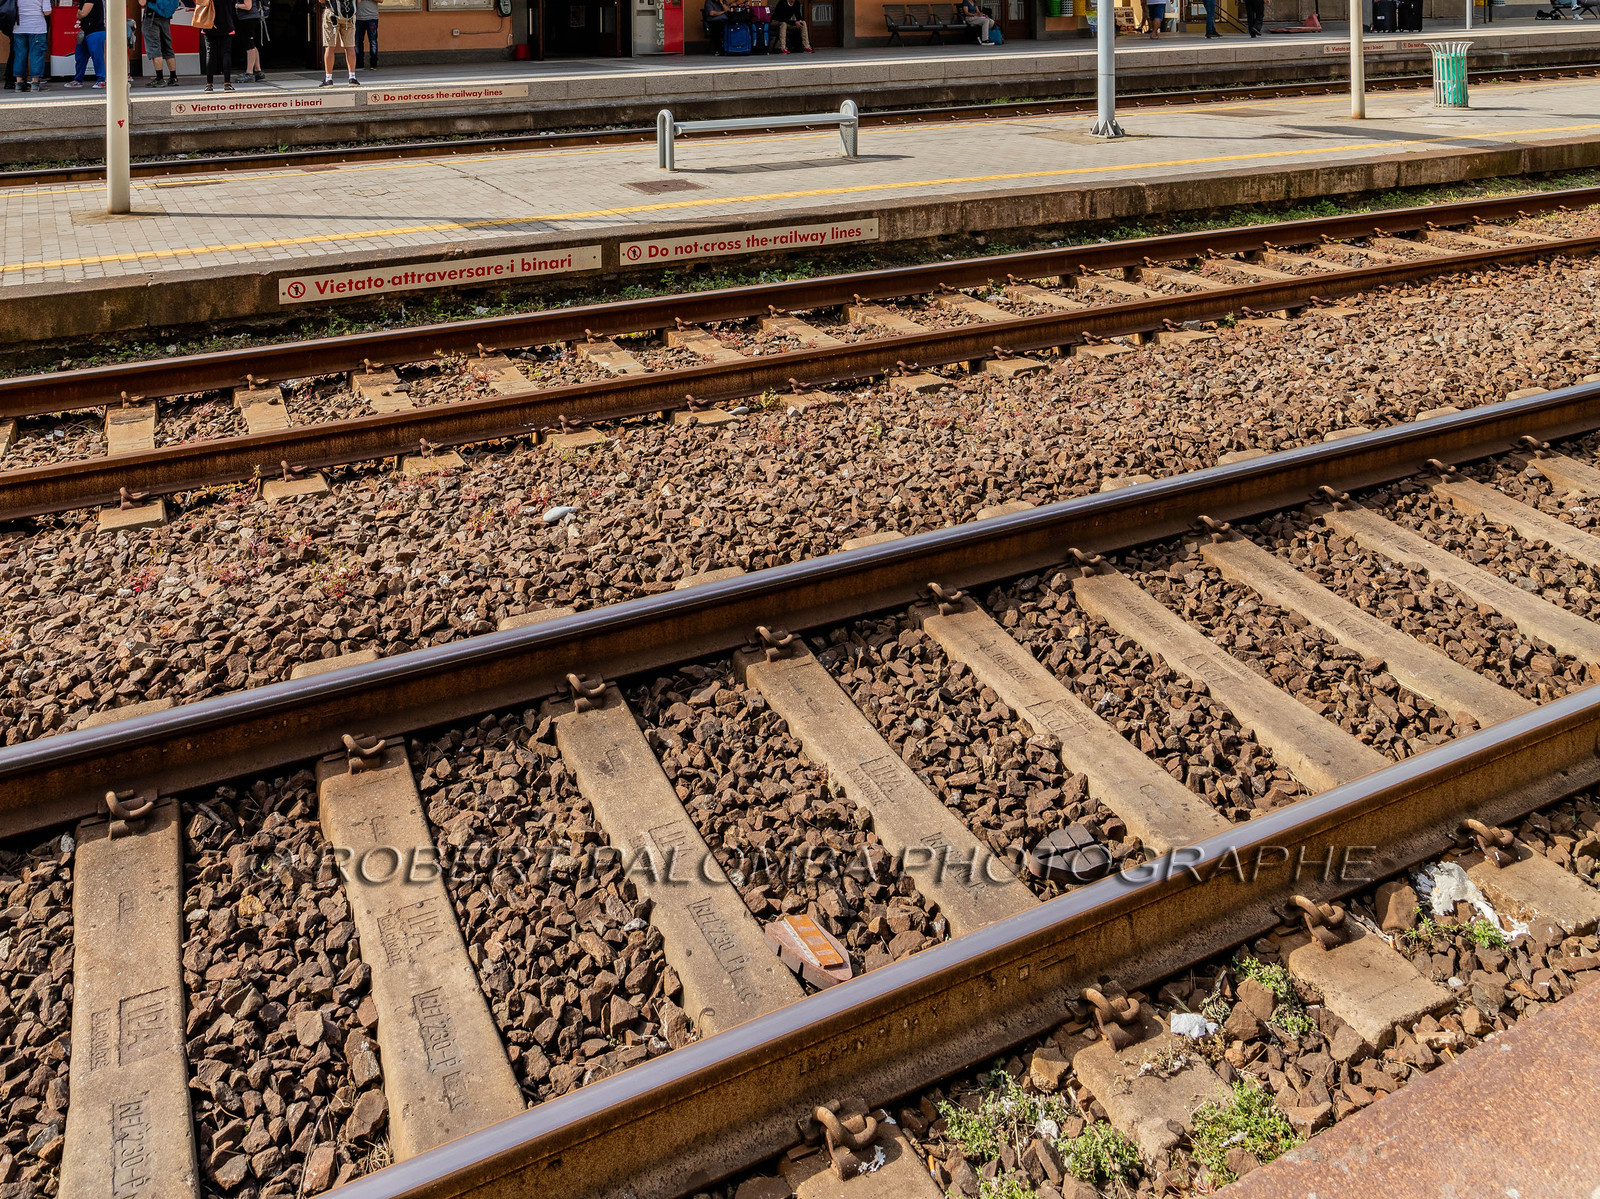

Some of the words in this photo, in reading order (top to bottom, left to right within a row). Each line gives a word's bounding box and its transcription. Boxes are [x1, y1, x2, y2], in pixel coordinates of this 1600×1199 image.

[191, 104, 226, 112] Vietato
[229, 100, 287, 110] attraversare
[295, 99, 322, 107] binari
[452, 90, 482, 99] railway
[648, 245, 669, 258] Do
[674, 242, 699, 255] not
[703, 240, 742, 252] cross
[746, 235, 768, 248] the
[773, 230, 827, 245] railway
[831, 226, 862, 238] lines
[314, 277, 384, 295] Vietato
[391, 262, 504, 286] attraversare
[510, 260, 514, 272] i
[521, 254, 573, 272] binari
